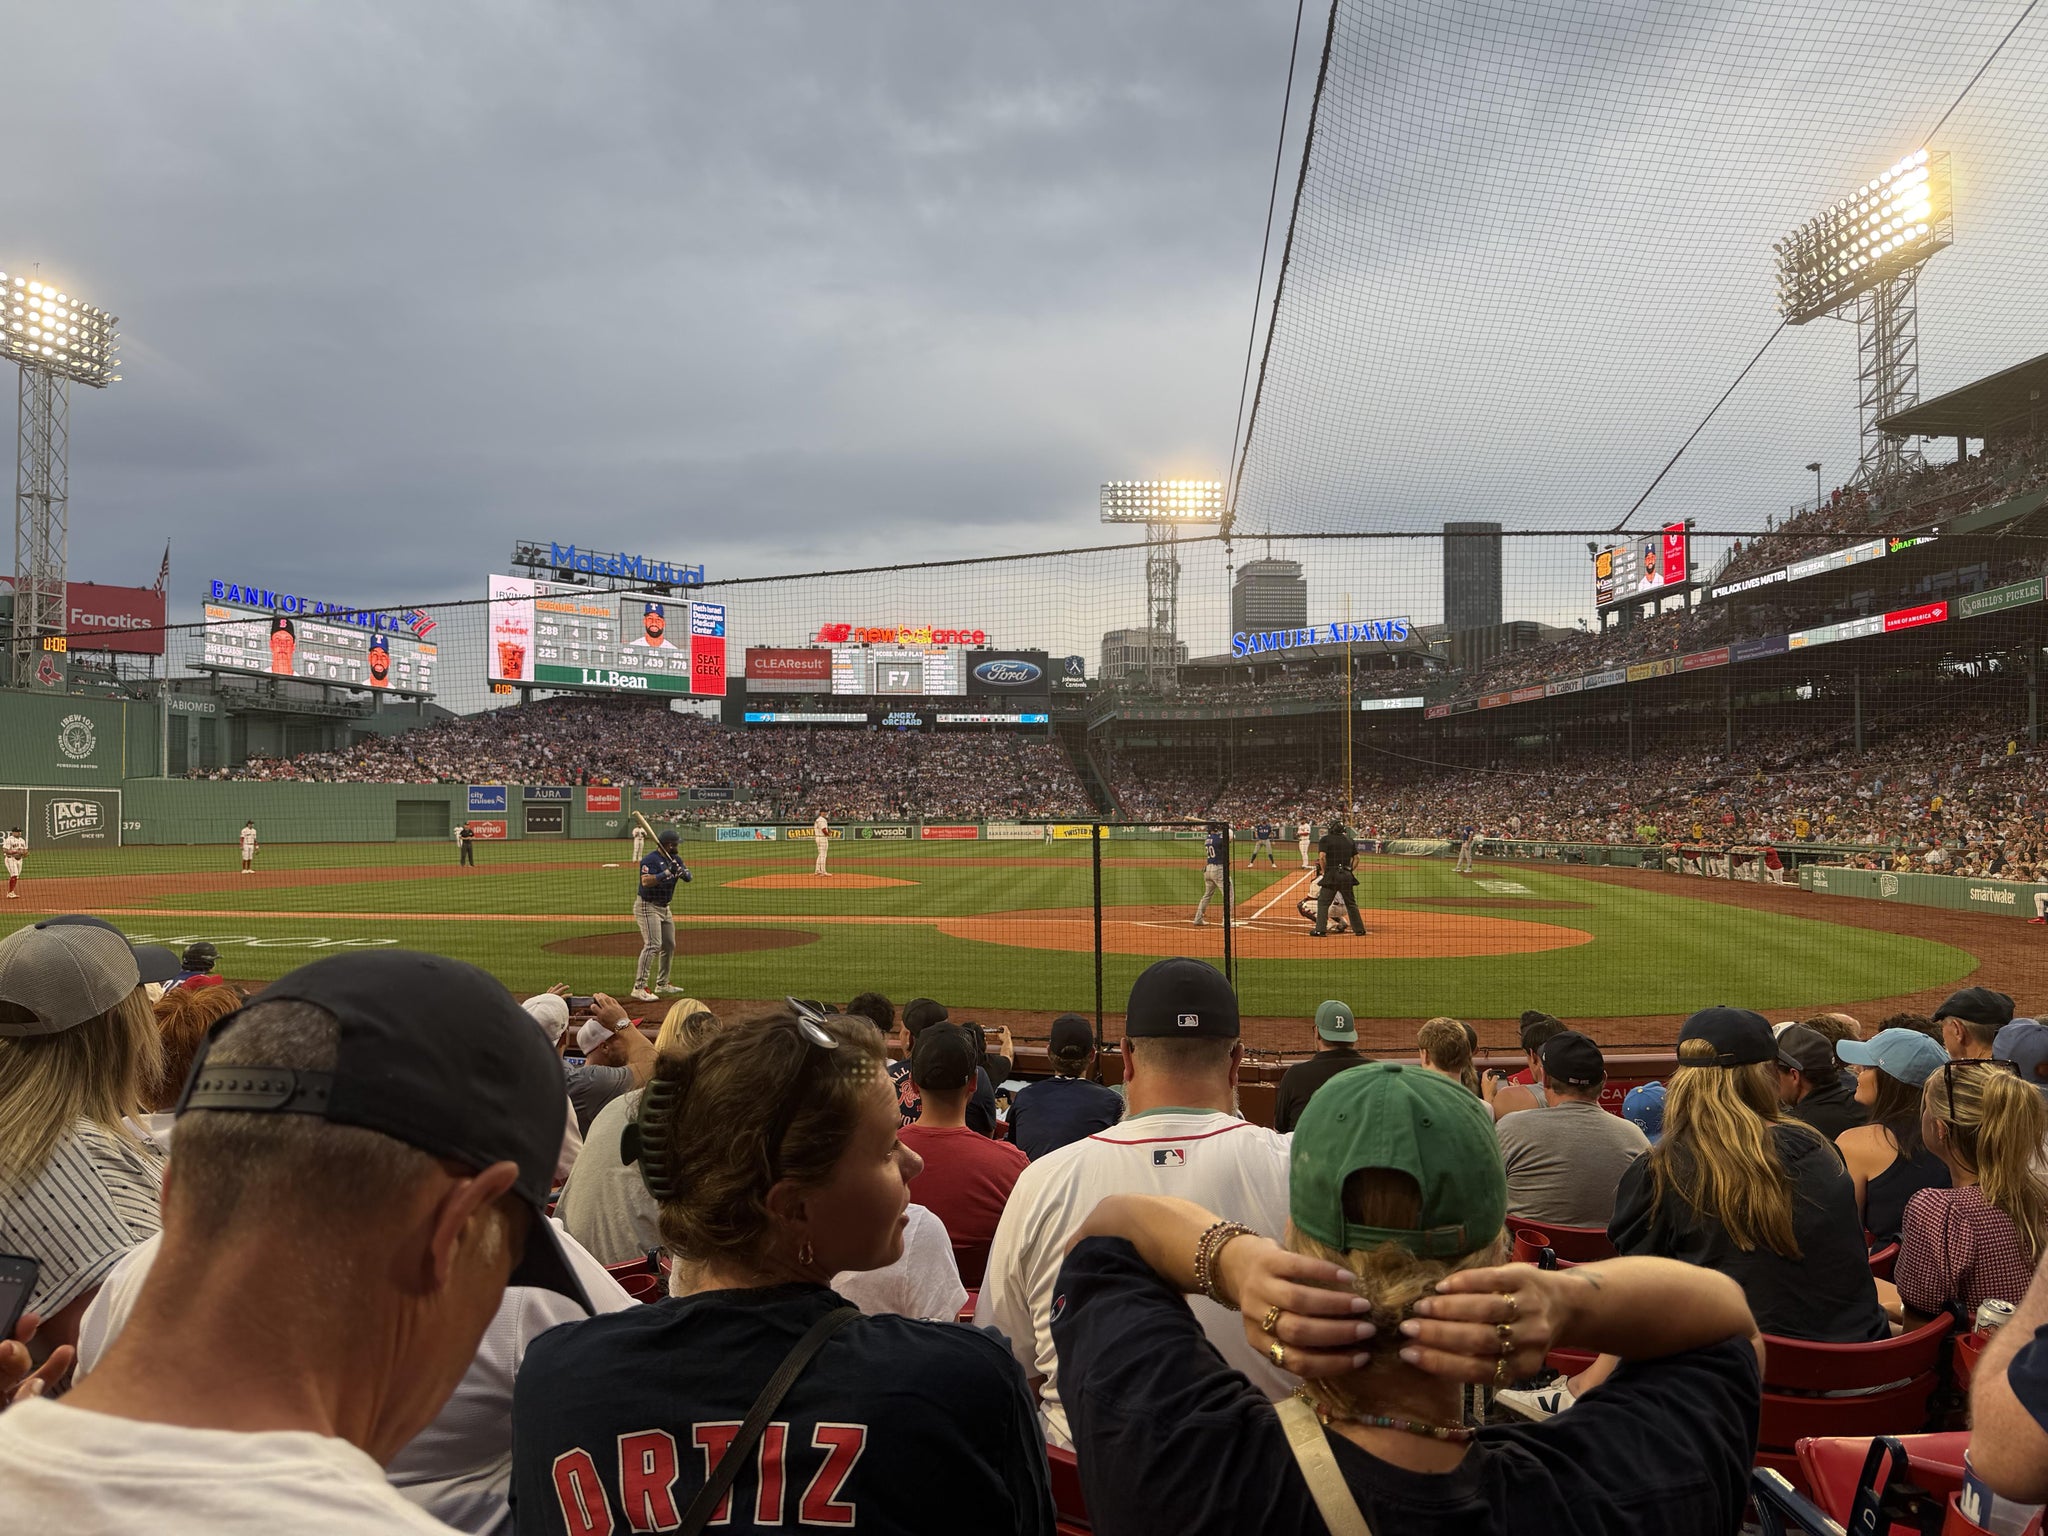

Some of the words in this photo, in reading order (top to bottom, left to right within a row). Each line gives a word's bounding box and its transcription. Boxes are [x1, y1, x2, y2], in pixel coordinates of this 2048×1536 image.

[551, 542, 704, 589] MassMutual
[1721, 582, 1742, 596] BLACK
[1742, 577, 1760, 590] LIVES
[1761, 570, 1786, 585] MATTER
[1971, 594, 2003, 610] GRILLO'S
[2006, 585, 2040, 602] PICKLES
[211, 579, 275, 610] BANK
[282, 594, 308, 615] OF
[315, 601, 400, 633] AMERICA
[693, 603, 705, 611] Beth
[706, 606, 722, 614] Israel
[71, 608, 152, 630] Fanatics
[693, 612, 723, 622] Deaconess
[693, 620, 715, 628] Medical
[1887, 619, 1901, 627] BANK
[1908, 612, 1931, 623] AMERICA
[537, 625, 558, 636] .288
[573, 629, 579, 638] 4
[596, 631, 608, 640] 35
[855, 627, 897, 643] new
[899, 624, 985, 644] balance
[1232, 627, 1321, 658] SAMUEL
[1324, 618, 1409, 643] ADAMS
[303, 651, 320, 661] BALLS
[323, 654, 344, 665] STRIKES
[538, 648, 557, 658] 225
[573, 651, 579, 660] 5
[697, 653, 720, 664] SEAT
[619, 656, 638, 666] .339
[644, 658, 663, 668] .439
[669, 660, 687, 670] .778
[754, 659, 823, 669] CLEAResult
[308, 663, 315, 675] 0
[329, 665, 337, 678] 0
[696, 665, 720, 676] GEEK
[987, 663, 1028, 680] Ford
[582, 668, 648, 689] L.L.Bean
[889, 671, 909, 687] F7
[1556, 680, 1579, 693] CABOT
[172, 700, 216, 713] ABIOMED
[60, 714, 81, 728] IBEW
[82, 716, 94, 731] 103
[470, 792, 484, 800] city
[656, 790, 679, 799] TICKET
[58, 802, 98, 820] ACE
[58, 817, 98, 831] TICKET
[122, 821, 141, 830] 379
[473, 826, 501, 834] IRVING
[873, 826, 907, 836] wasabi
[720, 828, 750, 840] jetBlue
[1064, 827, 1088, 838] TWISTED
[1970, 886, 2016, 904] smartwater
[1335, 1015, 1345, 1029] B
[552, 1421, 868, 1536] ORTIZ
